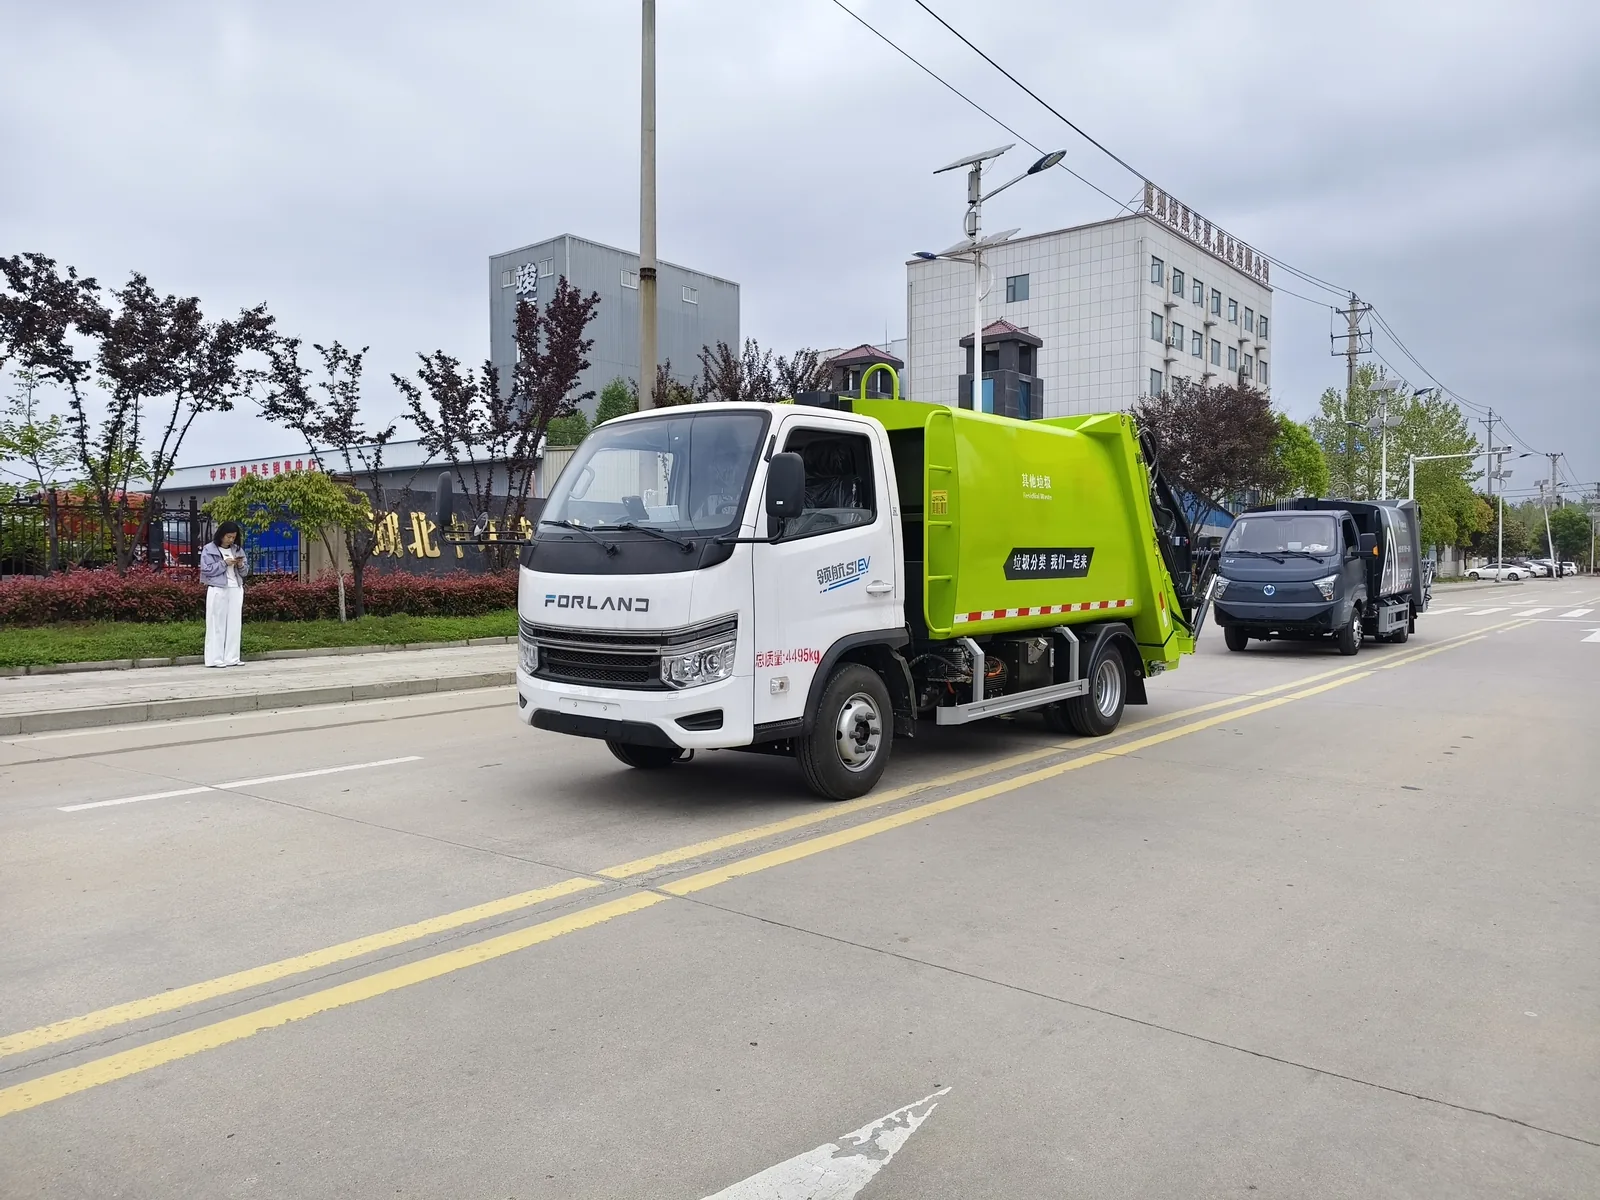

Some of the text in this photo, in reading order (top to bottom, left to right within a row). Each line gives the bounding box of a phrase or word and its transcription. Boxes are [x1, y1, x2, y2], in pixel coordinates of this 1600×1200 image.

[1021, 472, 1052, 489] 其他垃圾
[1012, 553, 1088, 571] 垃圾分类 我们一起来
[544, 594, 650, 613] FORLAND
